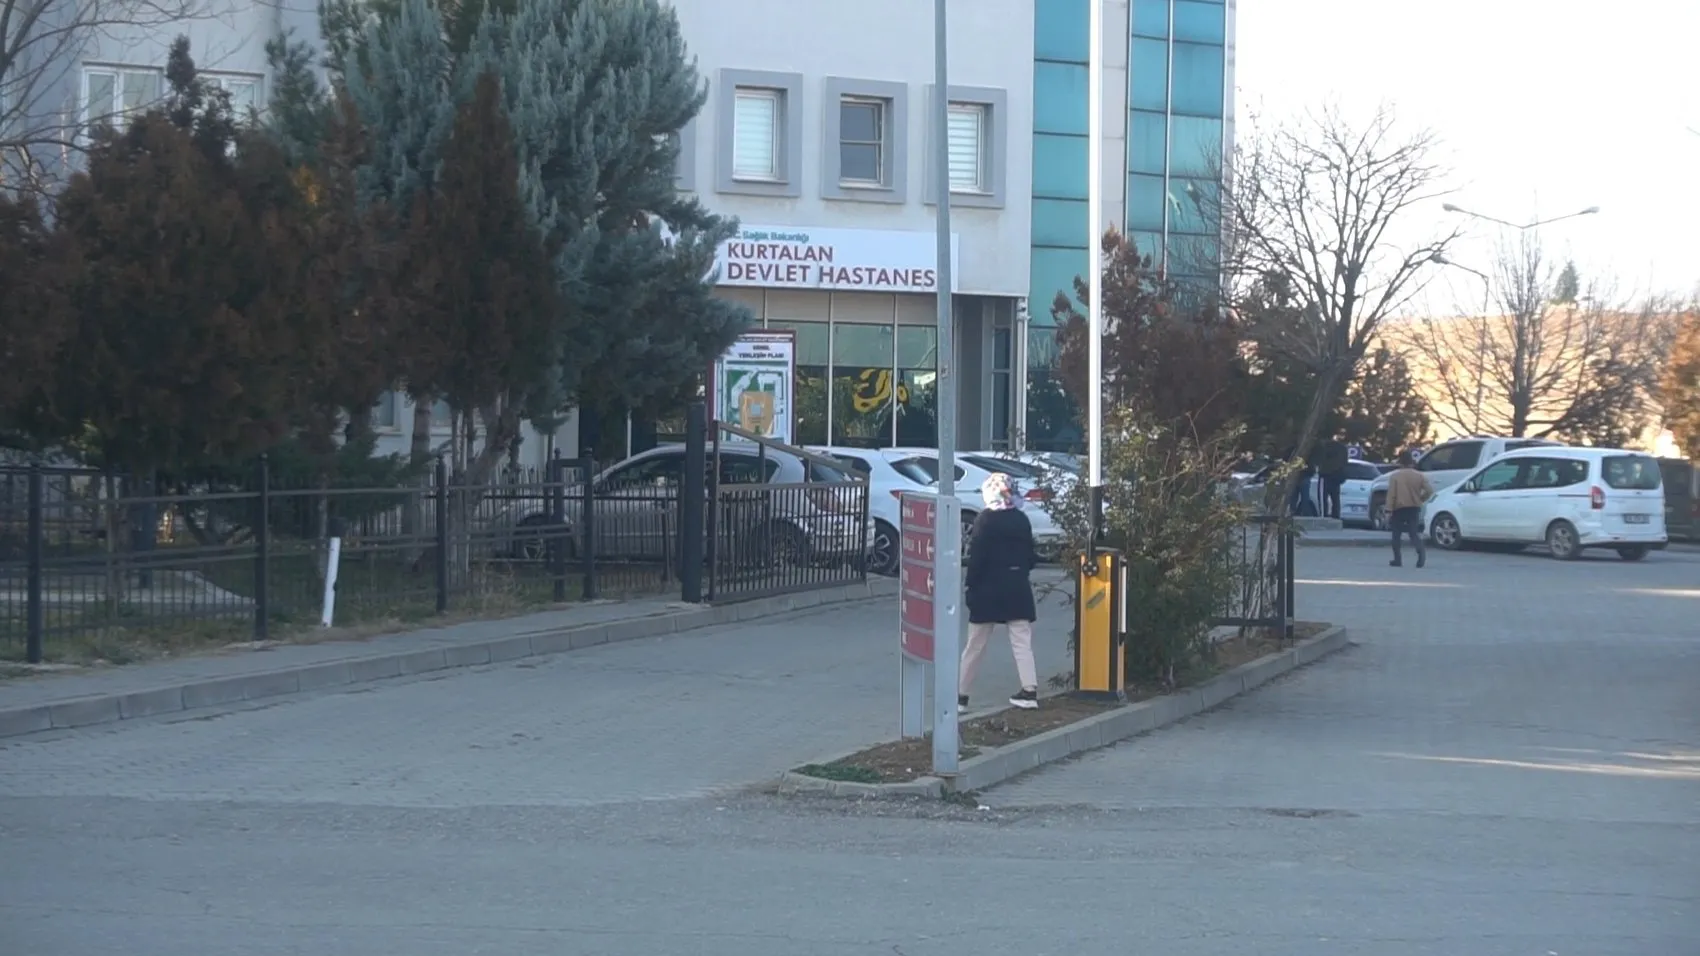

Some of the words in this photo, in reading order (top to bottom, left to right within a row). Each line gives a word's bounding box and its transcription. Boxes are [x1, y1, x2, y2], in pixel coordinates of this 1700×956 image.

[727, 242, 834, 262] KURTALAN
[727, 262, 811, 283] DEVLET
[818, 266, 936, 287] HASTANES
